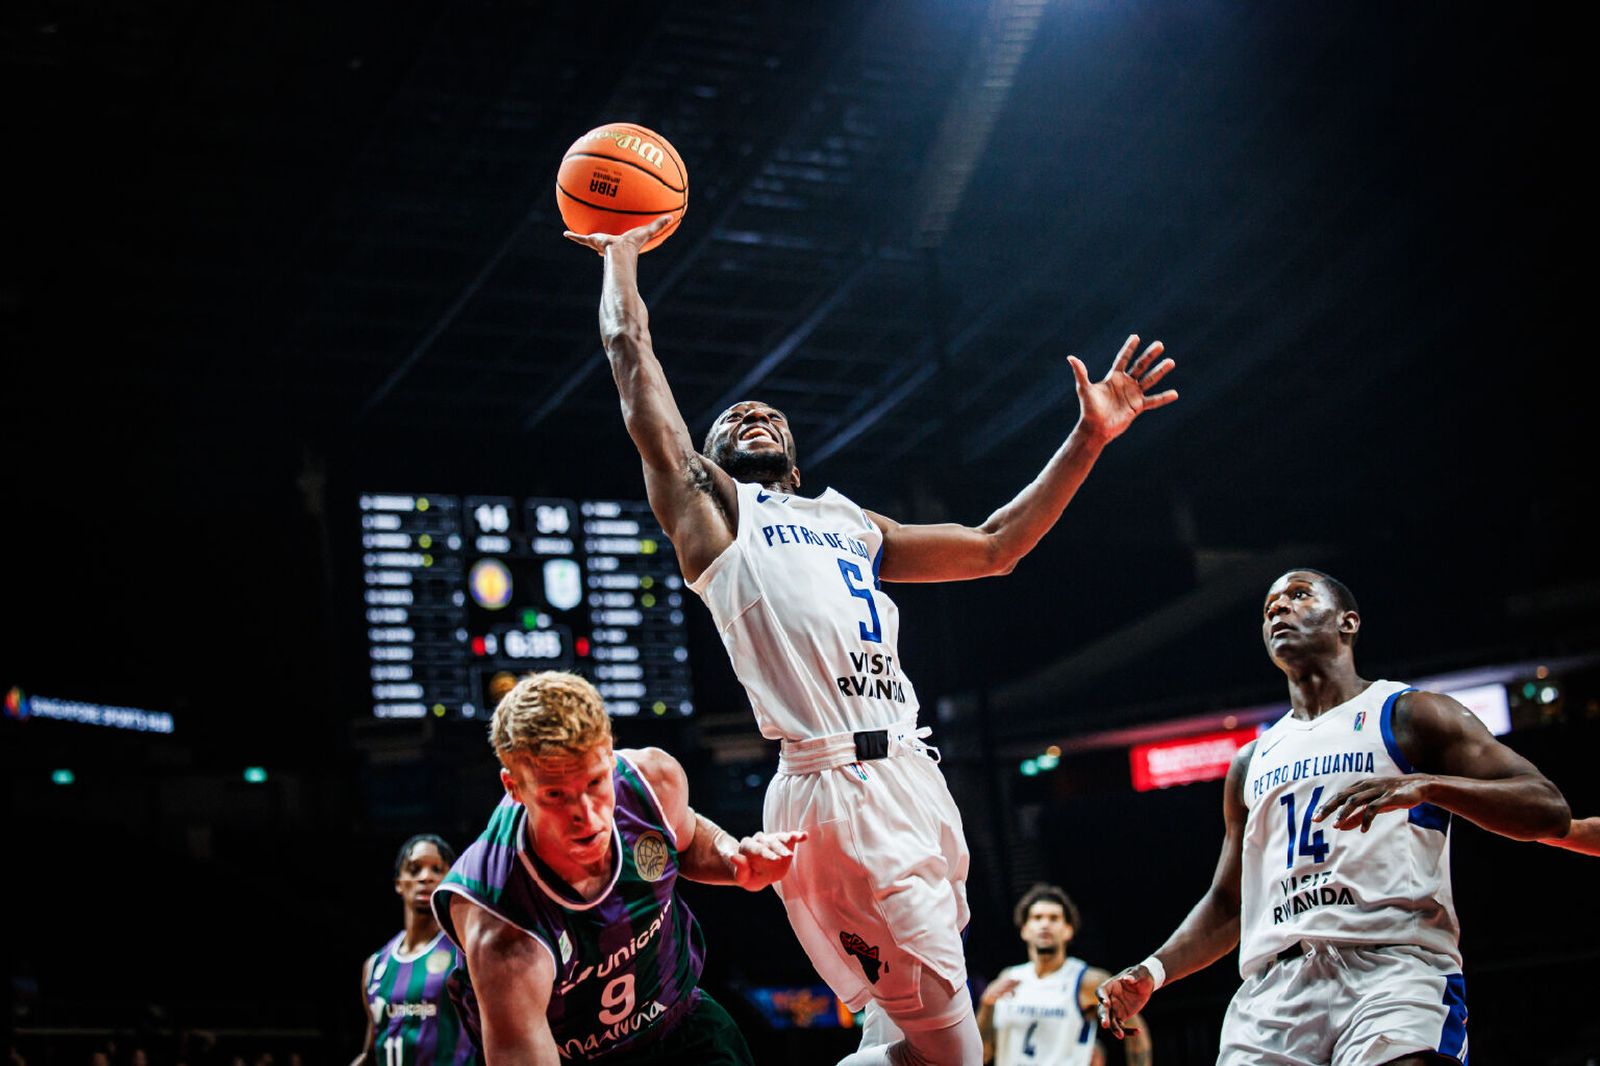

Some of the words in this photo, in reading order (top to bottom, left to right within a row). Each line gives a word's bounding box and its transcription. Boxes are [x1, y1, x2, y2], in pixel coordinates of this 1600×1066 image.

[590, 179, 618, 198] FIBA
[762, 524, 824, 548] PETRO
[823, 532, 848, 551] DE
[837, 557, 882, 644] 5
[849, 651, 896, 677] VISIT
[1253, 764, 1290, 800] PETRO
[1292, 758, 1312, 781] DE
[1313, 751, 1375, 777] LUANDA
[1280, 785, 1330, 869] 14
[1280, 870, 1332, 897] VISIT
[1273, 887, 1356, 925] RWANDA
[598, 972, 636, 1025] 9
[384, 1035, 403, 1066] 11
